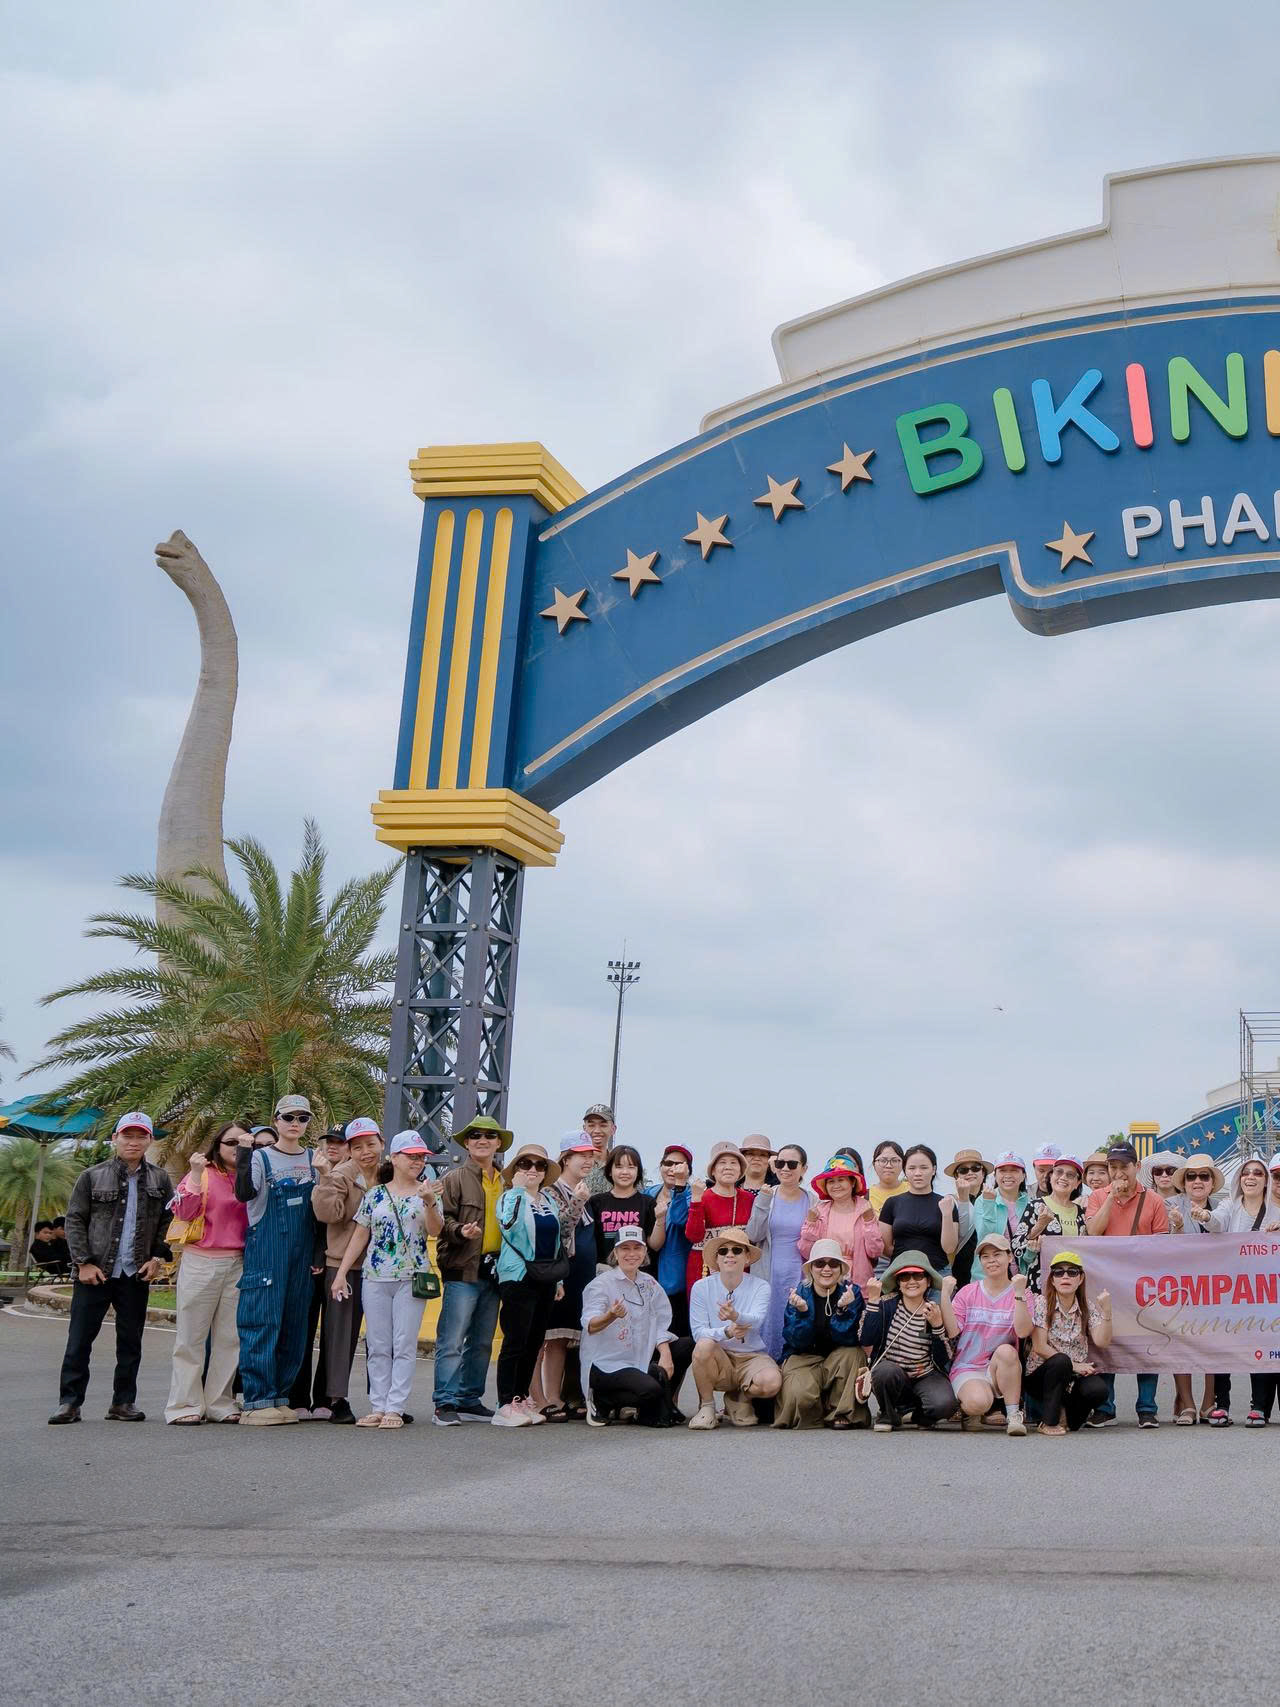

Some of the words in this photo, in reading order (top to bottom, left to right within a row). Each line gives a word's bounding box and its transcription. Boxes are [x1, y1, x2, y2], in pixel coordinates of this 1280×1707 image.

[601, 1211, 640, 1222] PINK
[602, 1221, 640, 1232] JEA
[1239, 1244, 1268, 1256] ATNS
